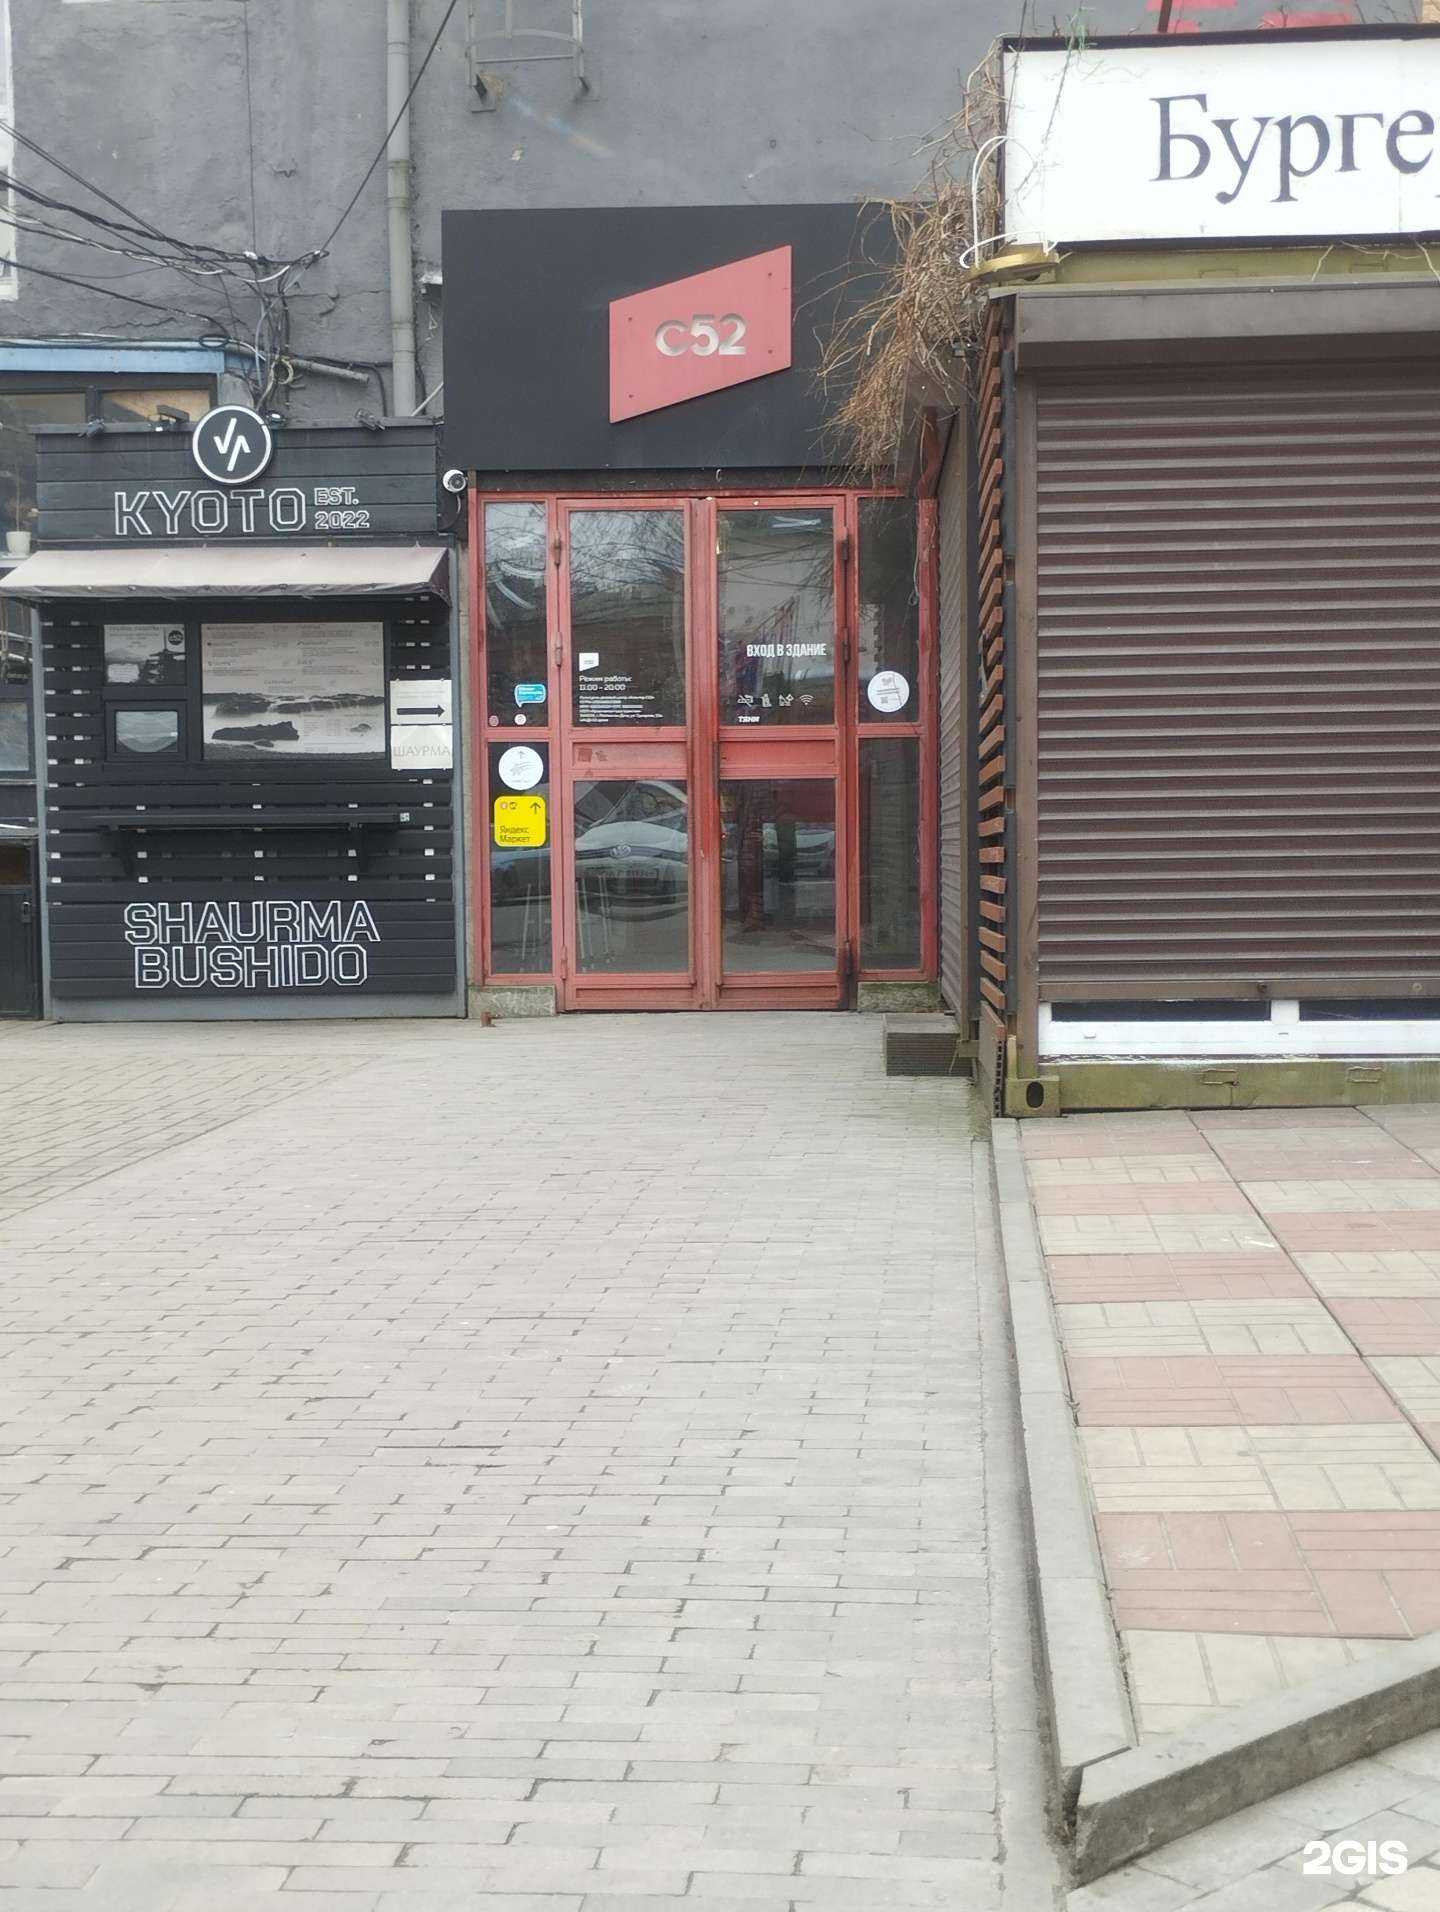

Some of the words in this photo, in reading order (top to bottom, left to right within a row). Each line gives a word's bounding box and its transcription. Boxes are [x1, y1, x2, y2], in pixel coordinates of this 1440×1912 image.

[1149, 93, 1440, 204] Бурге
[314, 487, 359, 506] EST.
[115, 488, 306, 535] KYOTO
[315, 511, 370, 529] 2022
[746, 644, 775, 658] ВХОД
[776, 644, 784, 656] В
[786, 643, 827, 657] ЗДАНИЕ
[393, 745, 451, 758] ШАУРМА
[500, 825, 529, 834] Яндекс
[500, 834, 530, 843] Маркет
[124, 900, 381, 946] SHAURMA
[135, 944, 368, 989] BUSHIDO
